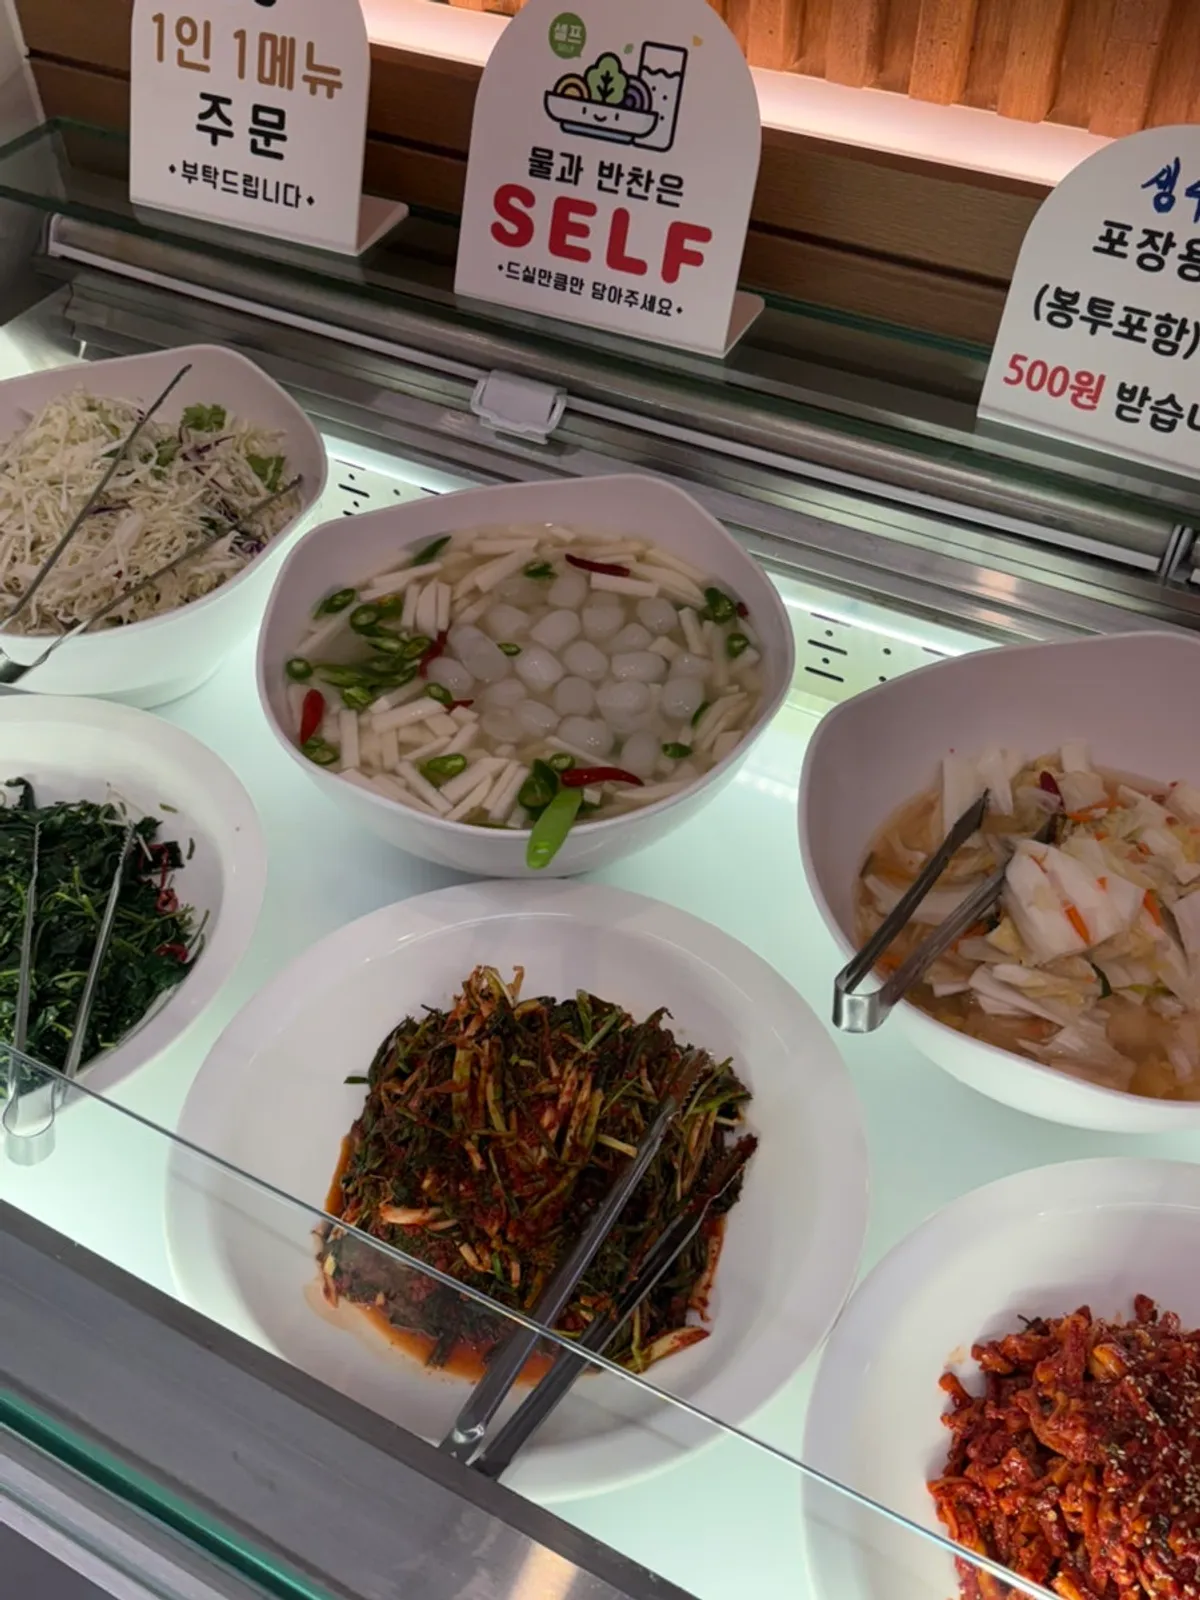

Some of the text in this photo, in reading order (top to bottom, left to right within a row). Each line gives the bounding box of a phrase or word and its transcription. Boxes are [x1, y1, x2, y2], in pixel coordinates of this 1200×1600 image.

[152, 12, 343, 99] 1인 1메뉴
[555, 23, 582, 44] 셀프
[181, 160, 302, 208] 부탁드립니다
[528, 146, 684, 208] 물과 반찬은
[490, 183, 712, 283] SELF
[505, 261, 673, 316] 드실만큼만 담아주세요
[1033, 284, 1200, 360] (봉투포함)
[1003, 353, 1106, 411] 500원
